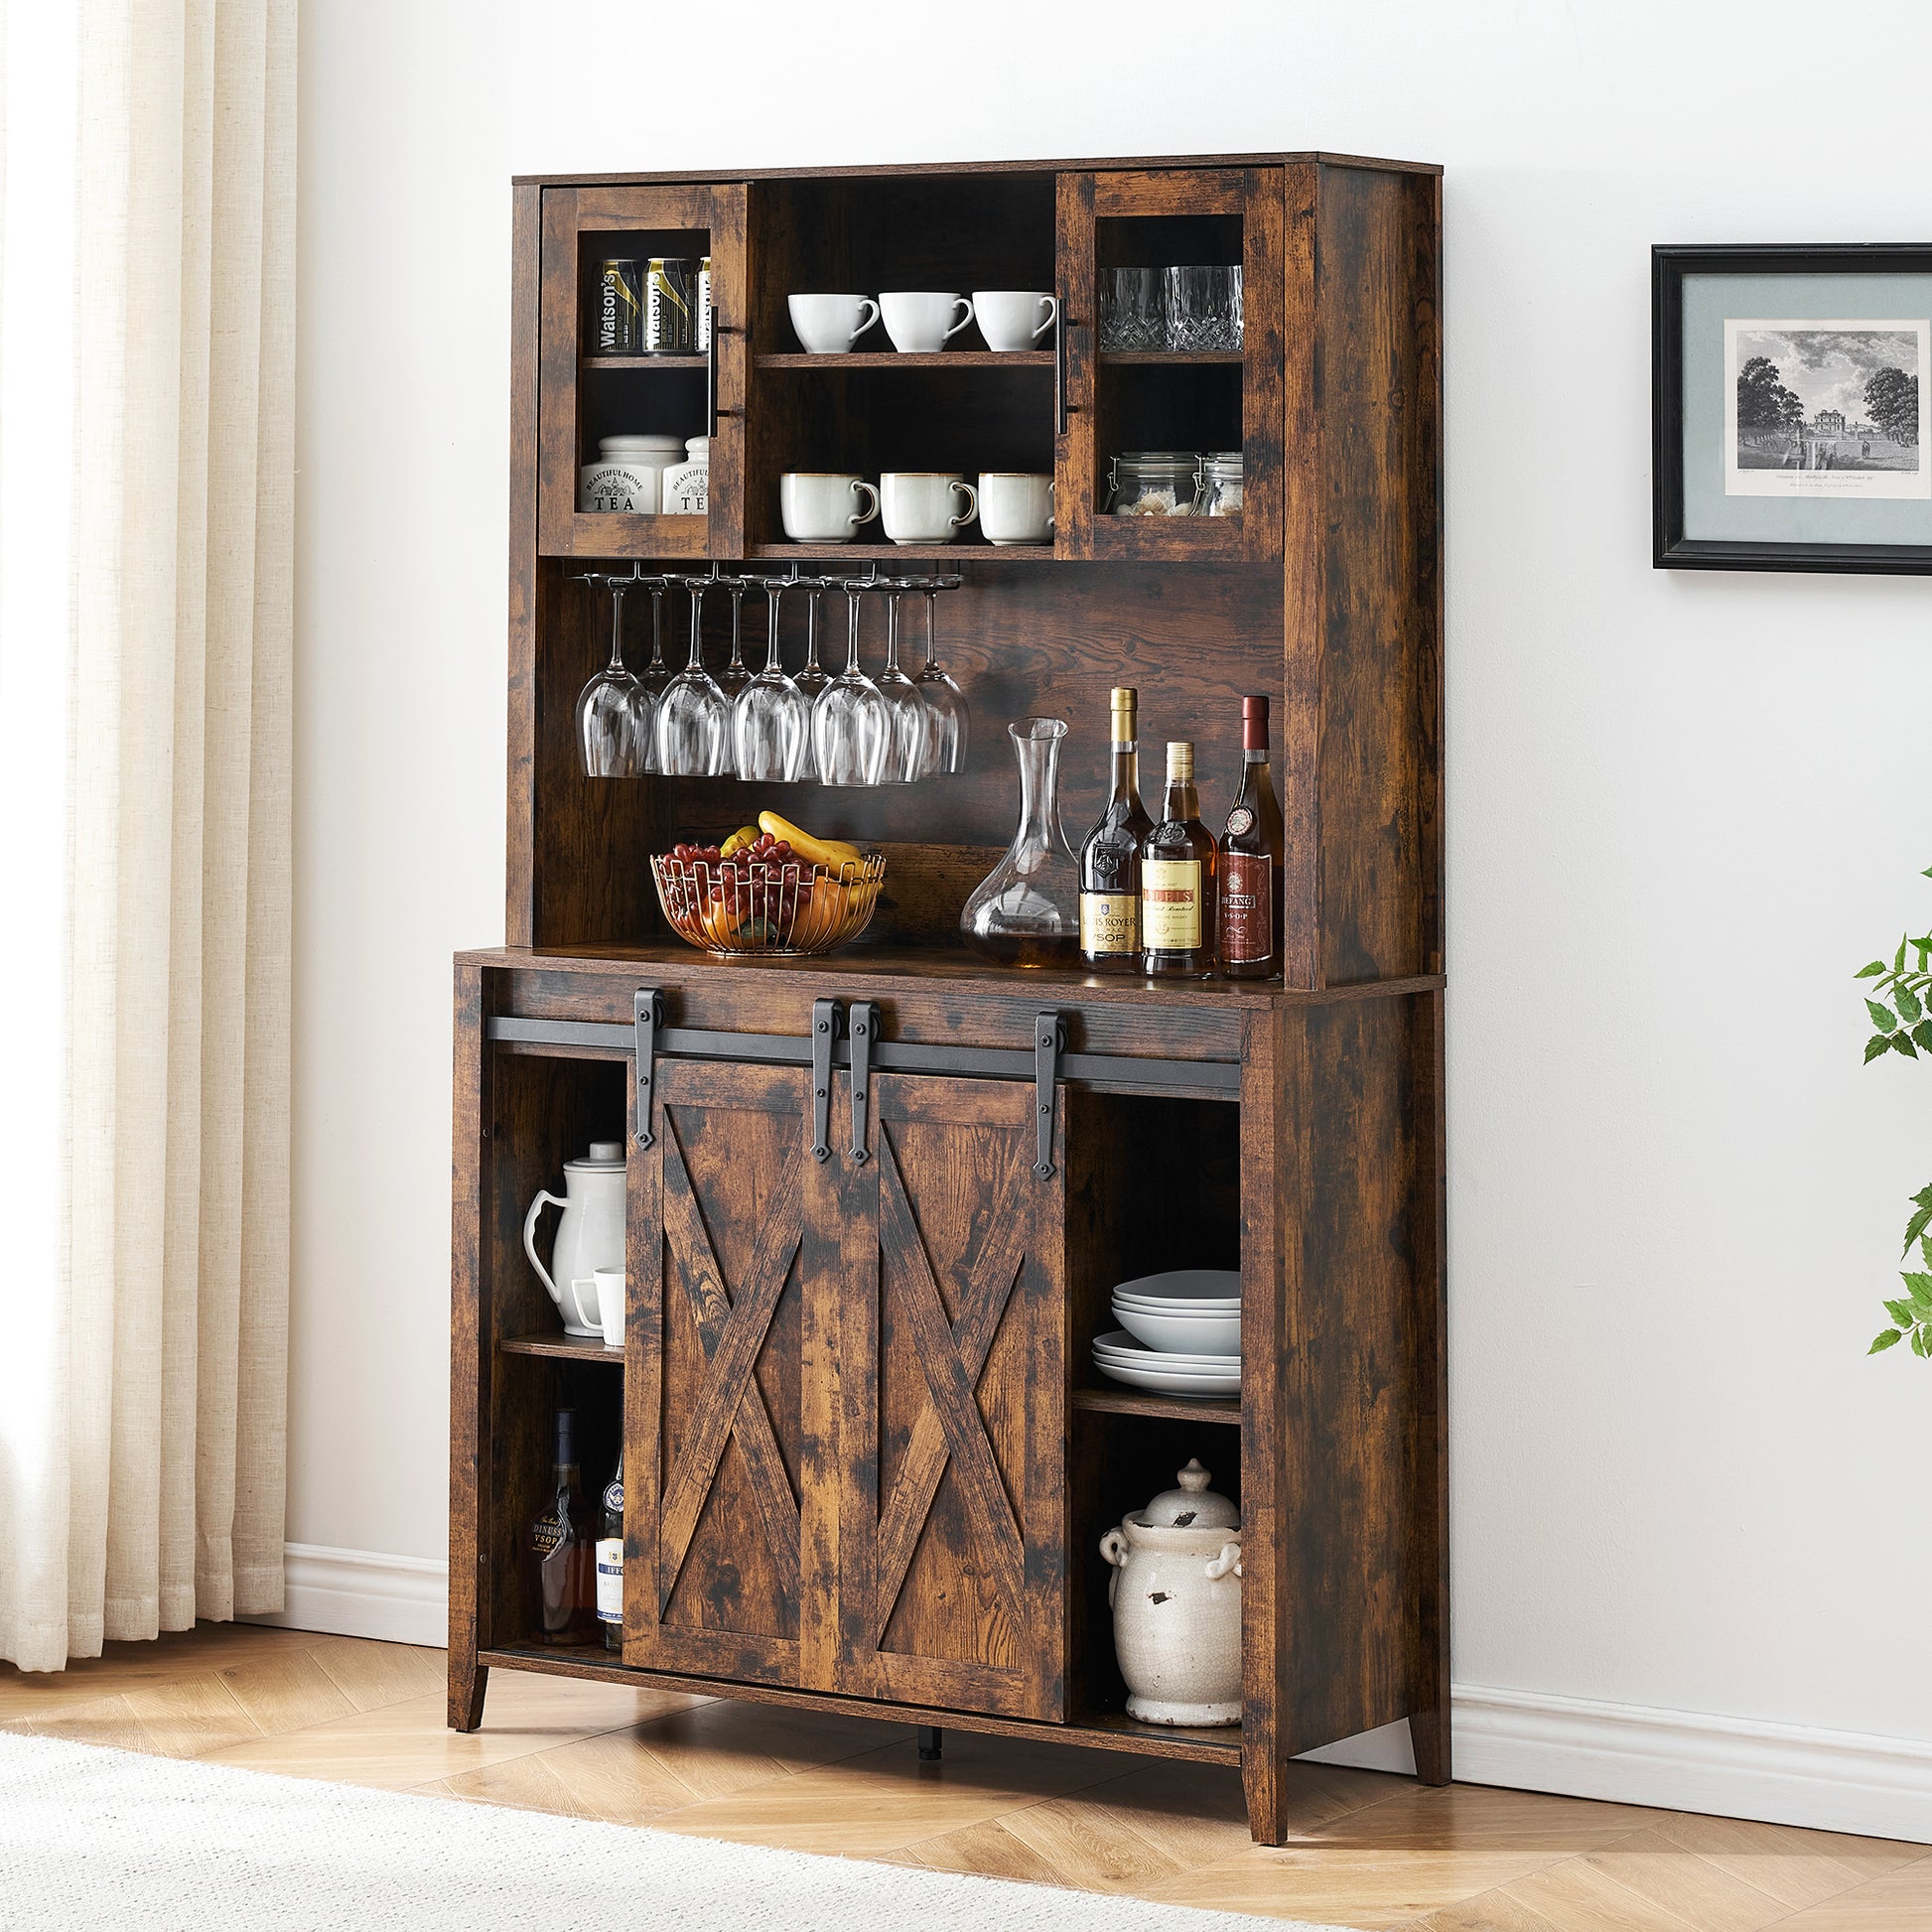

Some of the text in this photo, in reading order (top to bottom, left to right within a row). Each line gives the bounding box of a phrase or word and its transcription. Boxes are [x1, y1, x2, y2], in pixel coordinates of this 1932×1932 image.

[600, 274, 616, 347] Watson's
[586, 470, 643, 491] BEAUTIFUL HOME
[595, 497, 634, 510] TEA
[681, 497, 705, 510] TE
[1105, 917, 1137, 927] ROYER
[535, 1534, 558, 1545] VSOP
